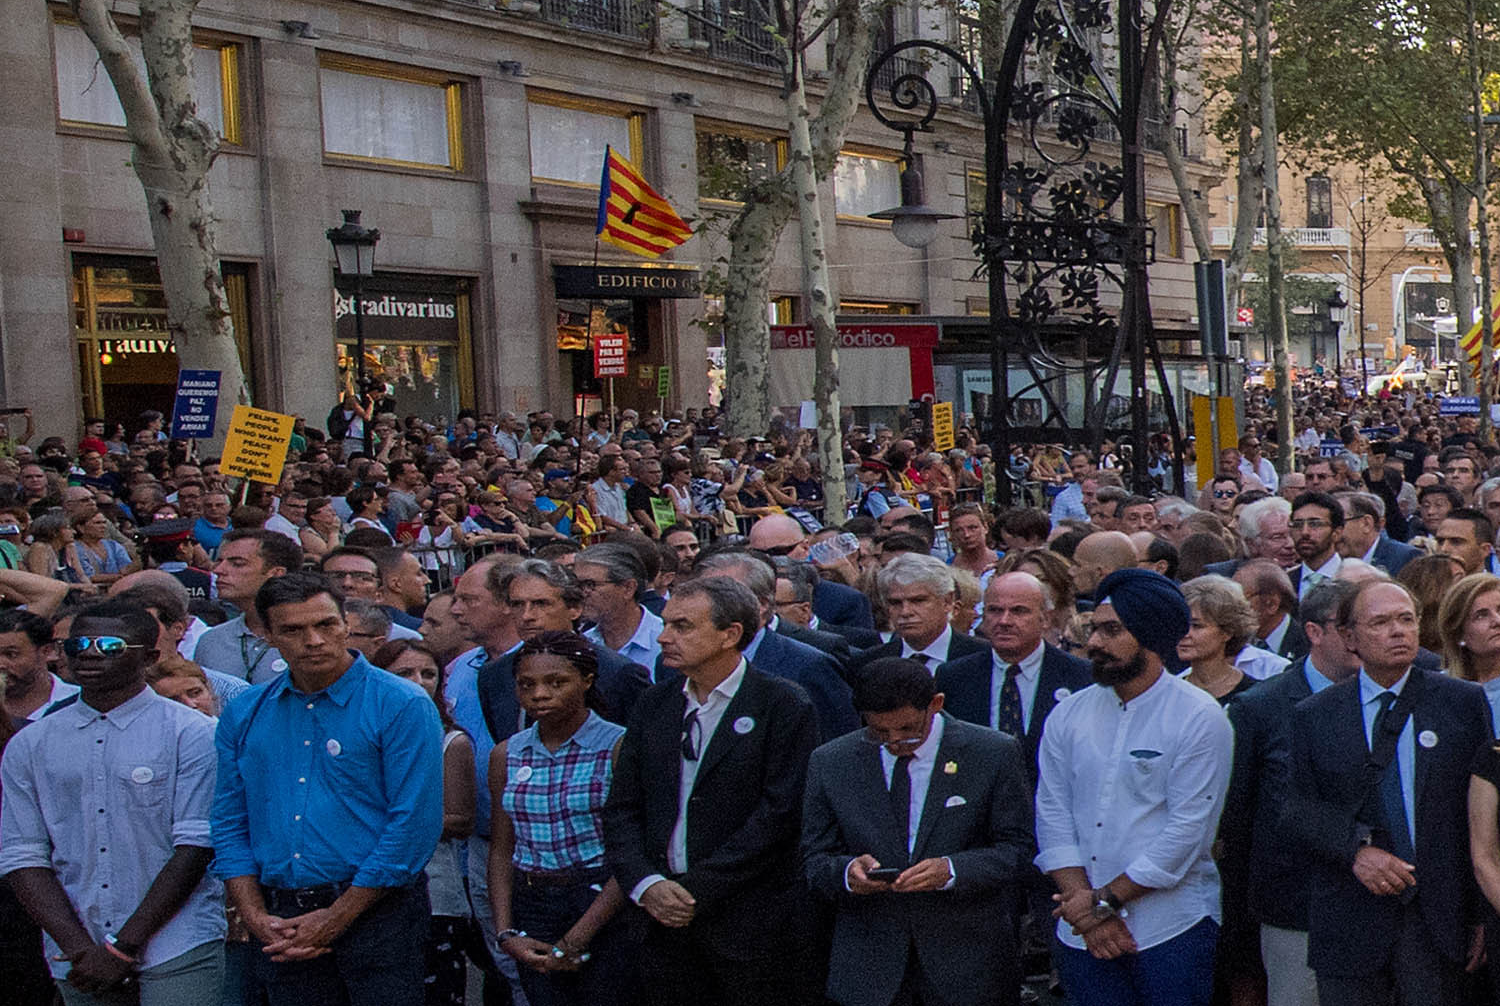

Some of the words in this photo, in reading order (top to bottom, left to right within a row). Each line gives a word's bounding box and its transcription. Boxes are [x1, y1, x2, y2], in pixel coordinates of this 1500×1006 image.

[597, 275, 677, 289] EDIFICIO
[788, 330, 804, 346] el
[807, 330, 896, 346] Piódico
[191, 406, 202, 414] NO
[245, 421, 279, 433] PEOPLE
[234, 427, 257, 437] WHO
[258, 433, 285, 443] WANT
[243, 439, 272, 450] PEACE
[235, 456, 259, 467] DEAL
